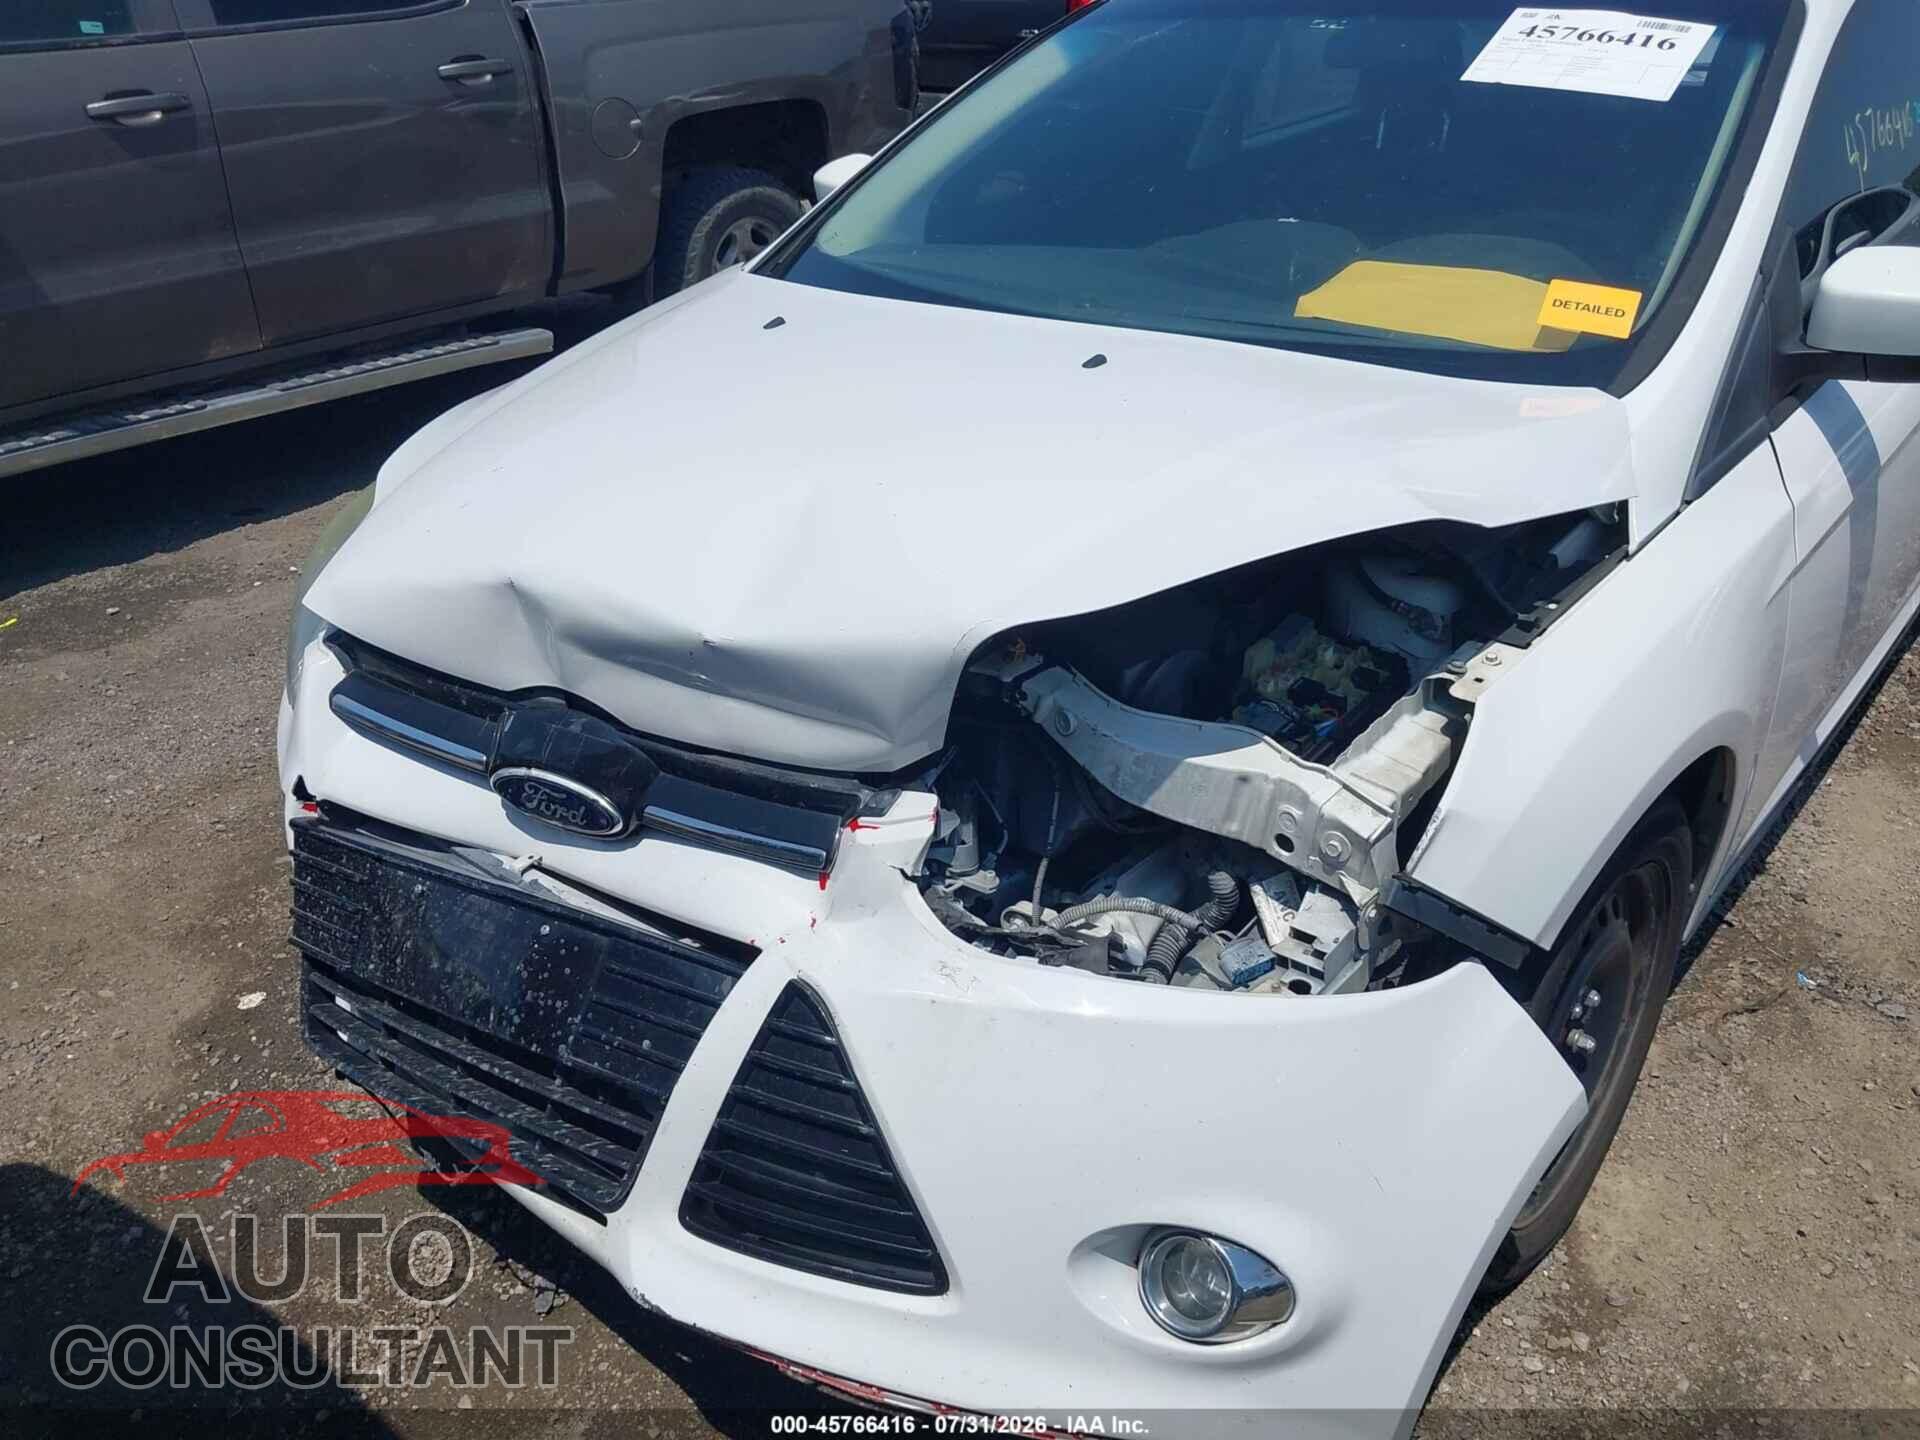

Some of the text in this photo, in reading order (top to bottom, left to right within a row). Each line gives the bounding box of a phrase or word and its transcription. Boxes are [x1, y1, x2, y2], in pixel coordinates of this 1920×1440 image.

[1518, 24, 1677, 51] 45766416
[1551, 298, 1626, 318] DETAILED
[521, 782, 587, 825] Ford
